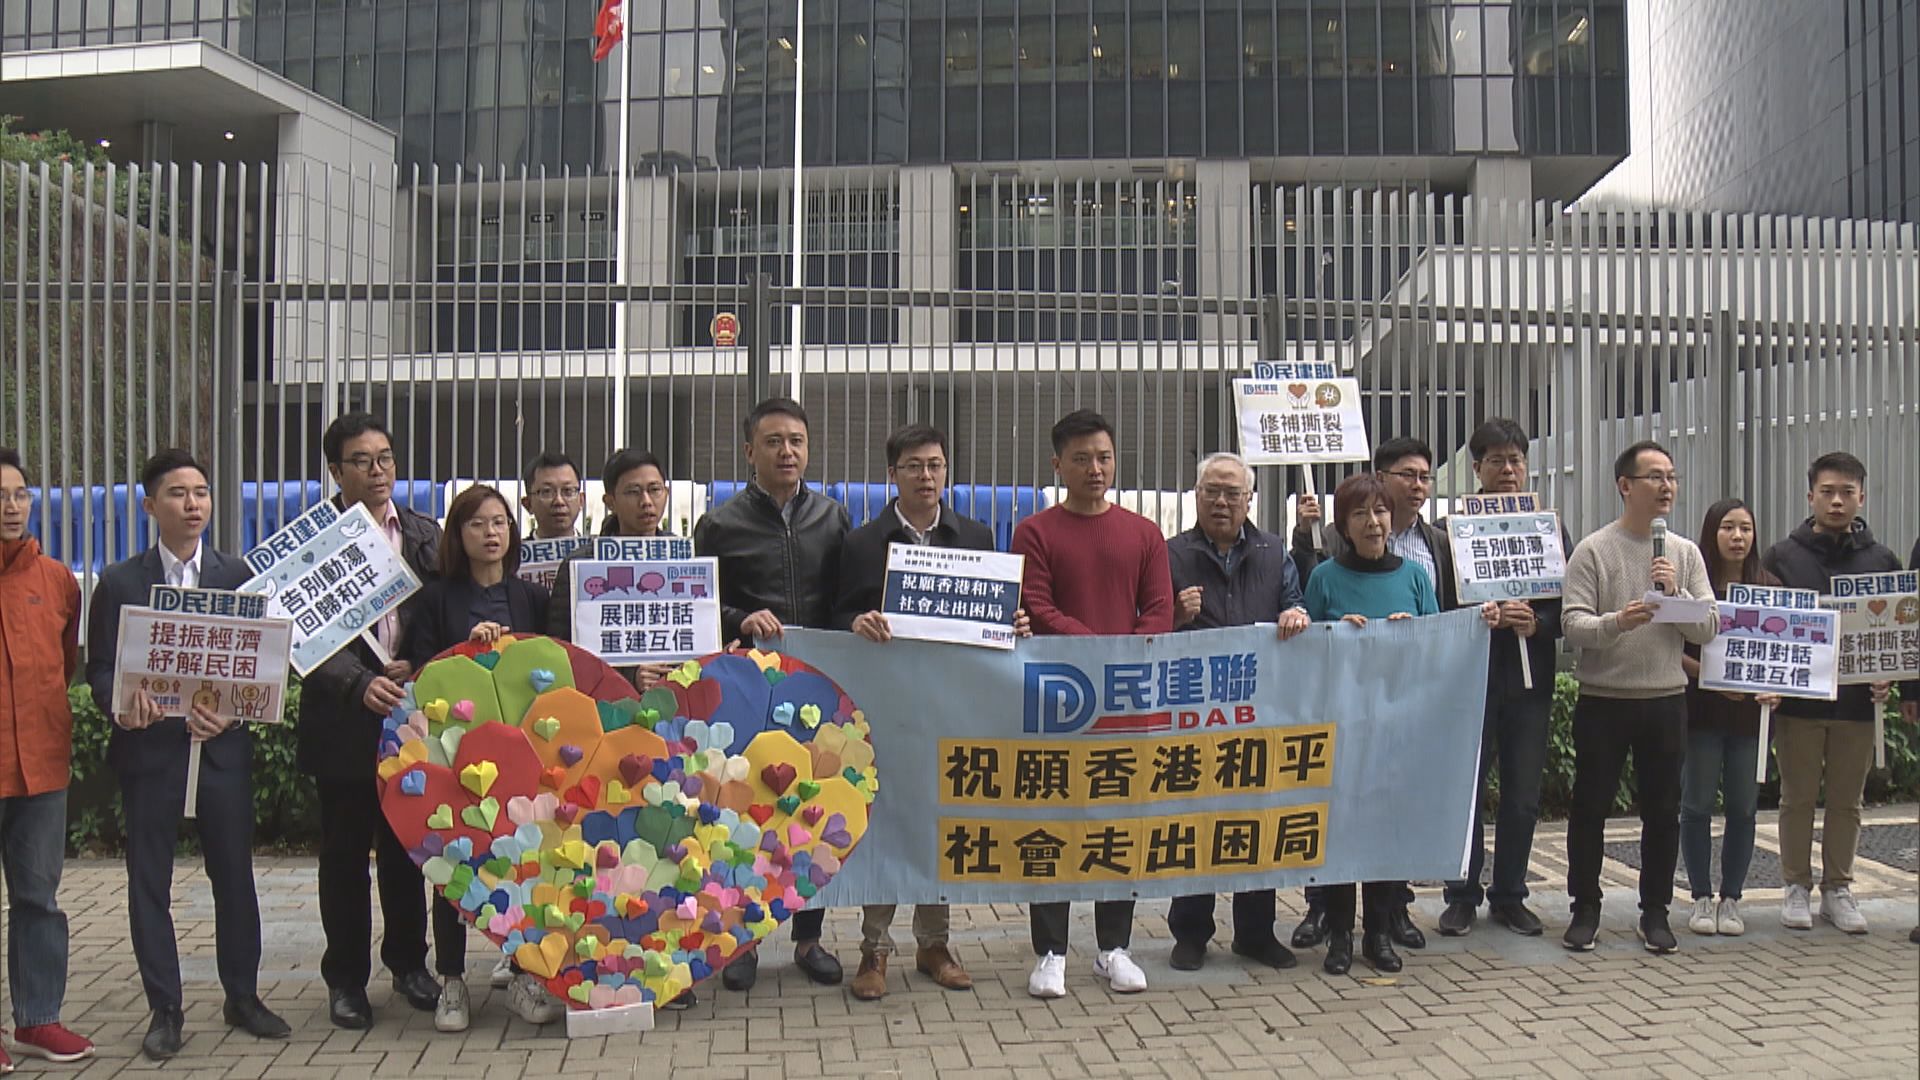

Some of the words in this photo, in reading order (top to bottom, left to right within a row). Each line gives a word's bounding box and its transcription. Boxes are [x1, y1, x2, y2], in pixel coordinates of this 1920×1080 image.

[1260, 413, 1342, 433] 修補撕裂
[1261, 432, 1344, 453] 理性包容
[1471, 536, 1544, 558] 告別動蕩
[280, 542, 368, 616] 告別動蕩
[1474, 556, 1547, 580] 回歸和平
[902, 573, 1005, 599] 祝願香港和平
[295, 564, 379, 638] 回歸和平
[600, 602, 694, 626] 展開對話
[899, 595, 1003, 621] 社會走出困局
[150, 621, 262, 653] 提振經濟
[600, 628, 694, 653] 重建互信
[147, 649, 257, 679] 紓解民困
[1725, 638, 1812, 665] 展開對話
[1839, 650, 1919, 675] 理性包容
[1104, 652, 1257, 711] 民建聯
[1723, 661, 1812, 688] 重建互信
[1178, 705, 1257, 730] DAB
[945, 732, 1329, 800] 祝願香港和平
[945, 811, 1321, 877] 社會走出困局
